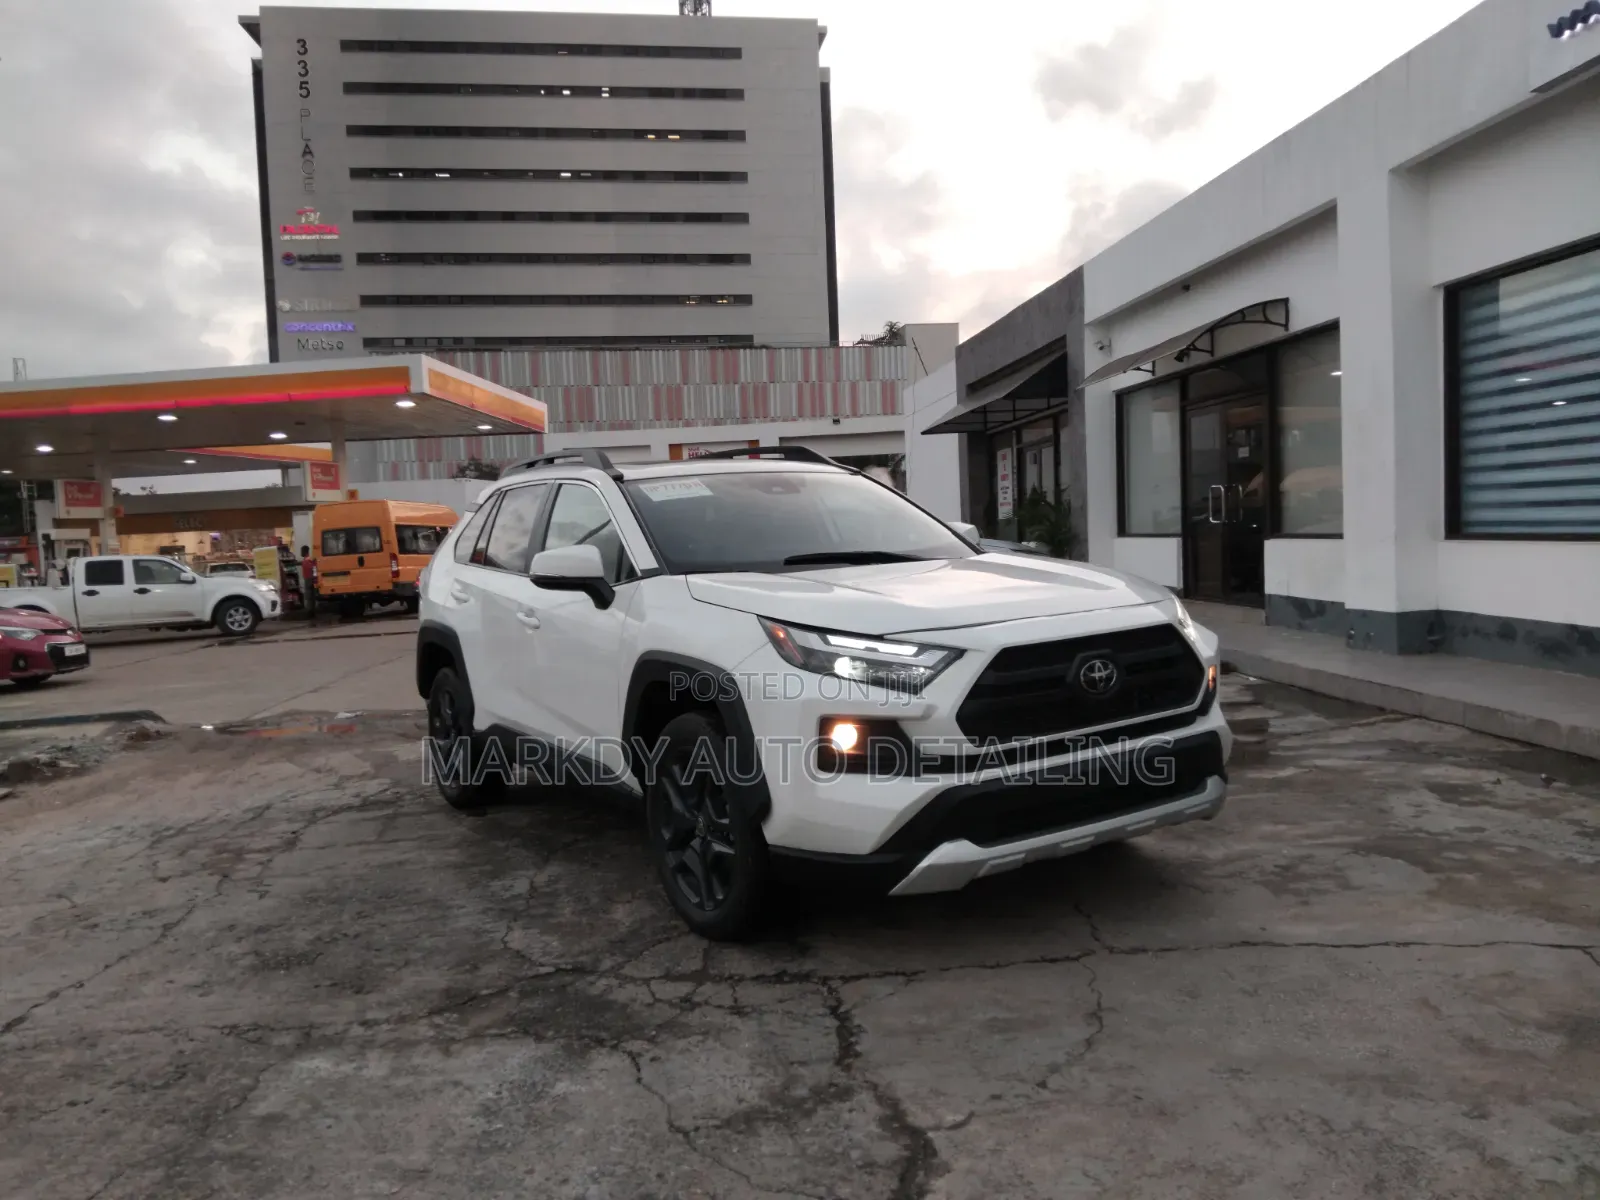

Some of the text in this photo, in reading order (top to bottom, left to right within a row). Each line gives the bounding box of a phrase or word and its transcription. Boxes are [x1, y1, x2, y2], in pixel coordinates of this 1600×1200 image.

[296, 38, 316, 193] 335 PLACE
[297, 337, 343, 350] Metso
